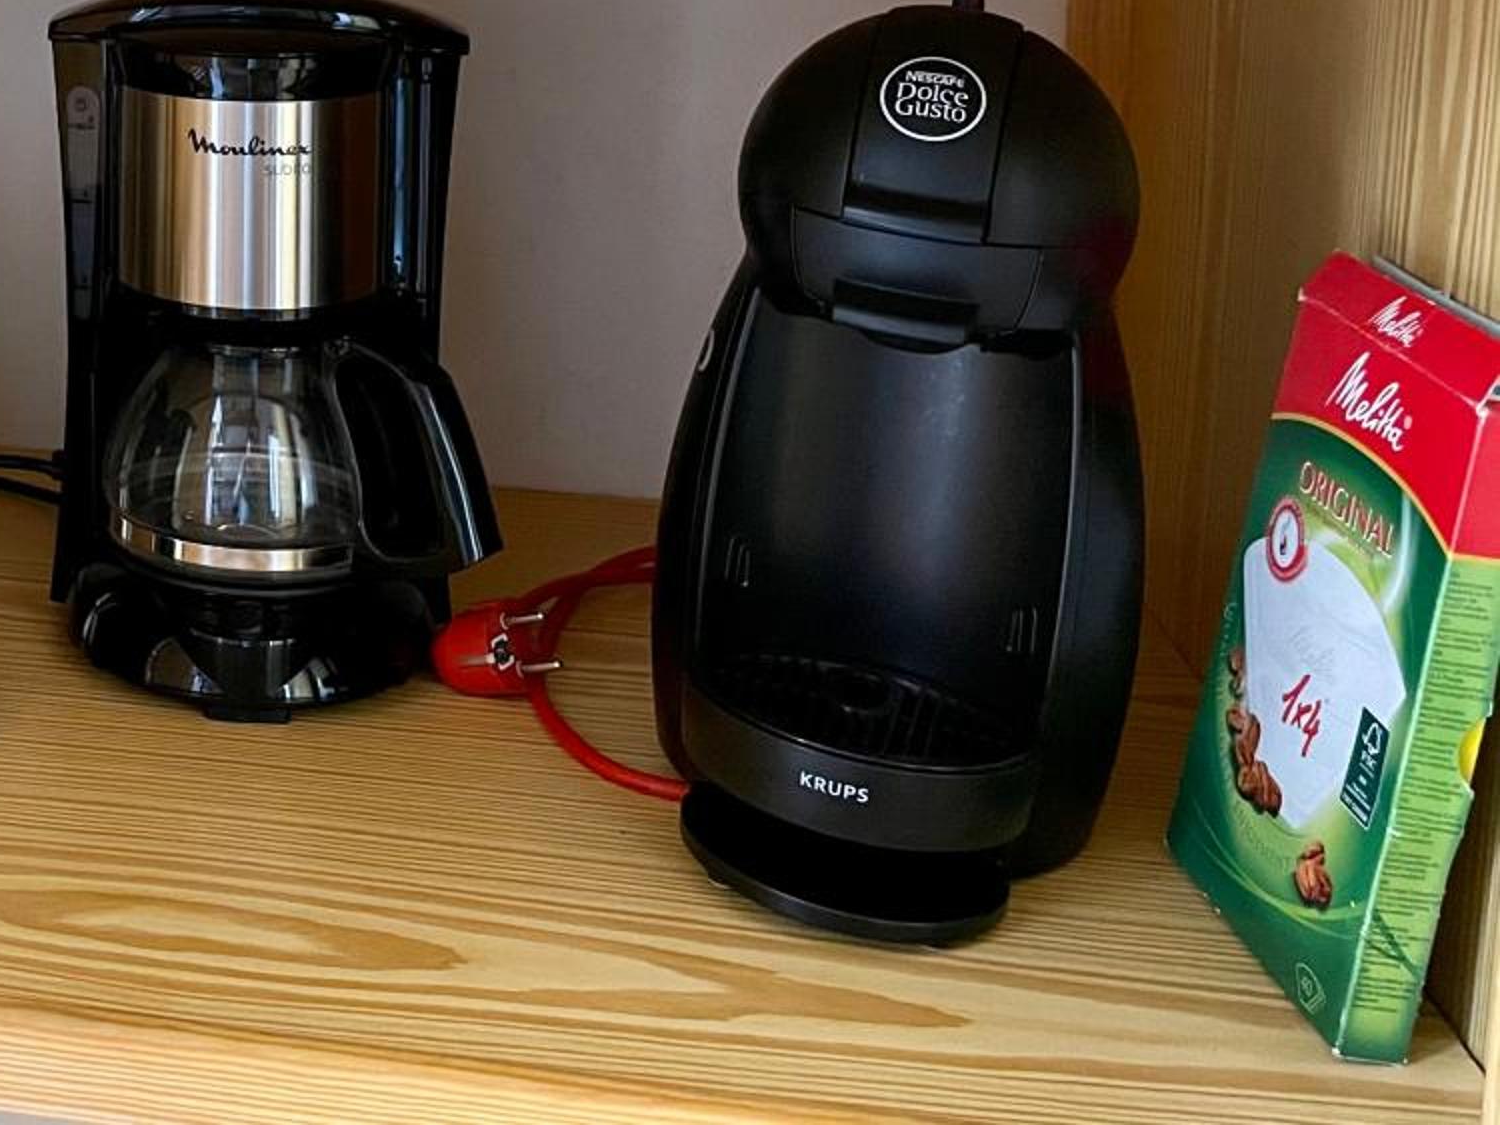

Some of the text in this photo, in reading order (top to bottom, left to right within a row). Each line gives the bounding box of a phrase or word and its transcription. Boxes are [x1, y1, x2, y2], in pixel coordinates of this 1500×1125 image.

[895, 98, 967, 123] Gusto
[897, 82, 969, 107] Dolce
[188, 128, 311, 156] Moulinex
[1367, 295, 1421, 348] Melitta
[1323, 351, 1404, 452] Melitta
[1299, 461, 1394, 559] ORIGINAL
[1281, 674, 1322, 758] 1x4
[800, 771, 869, 803] KRUPS
